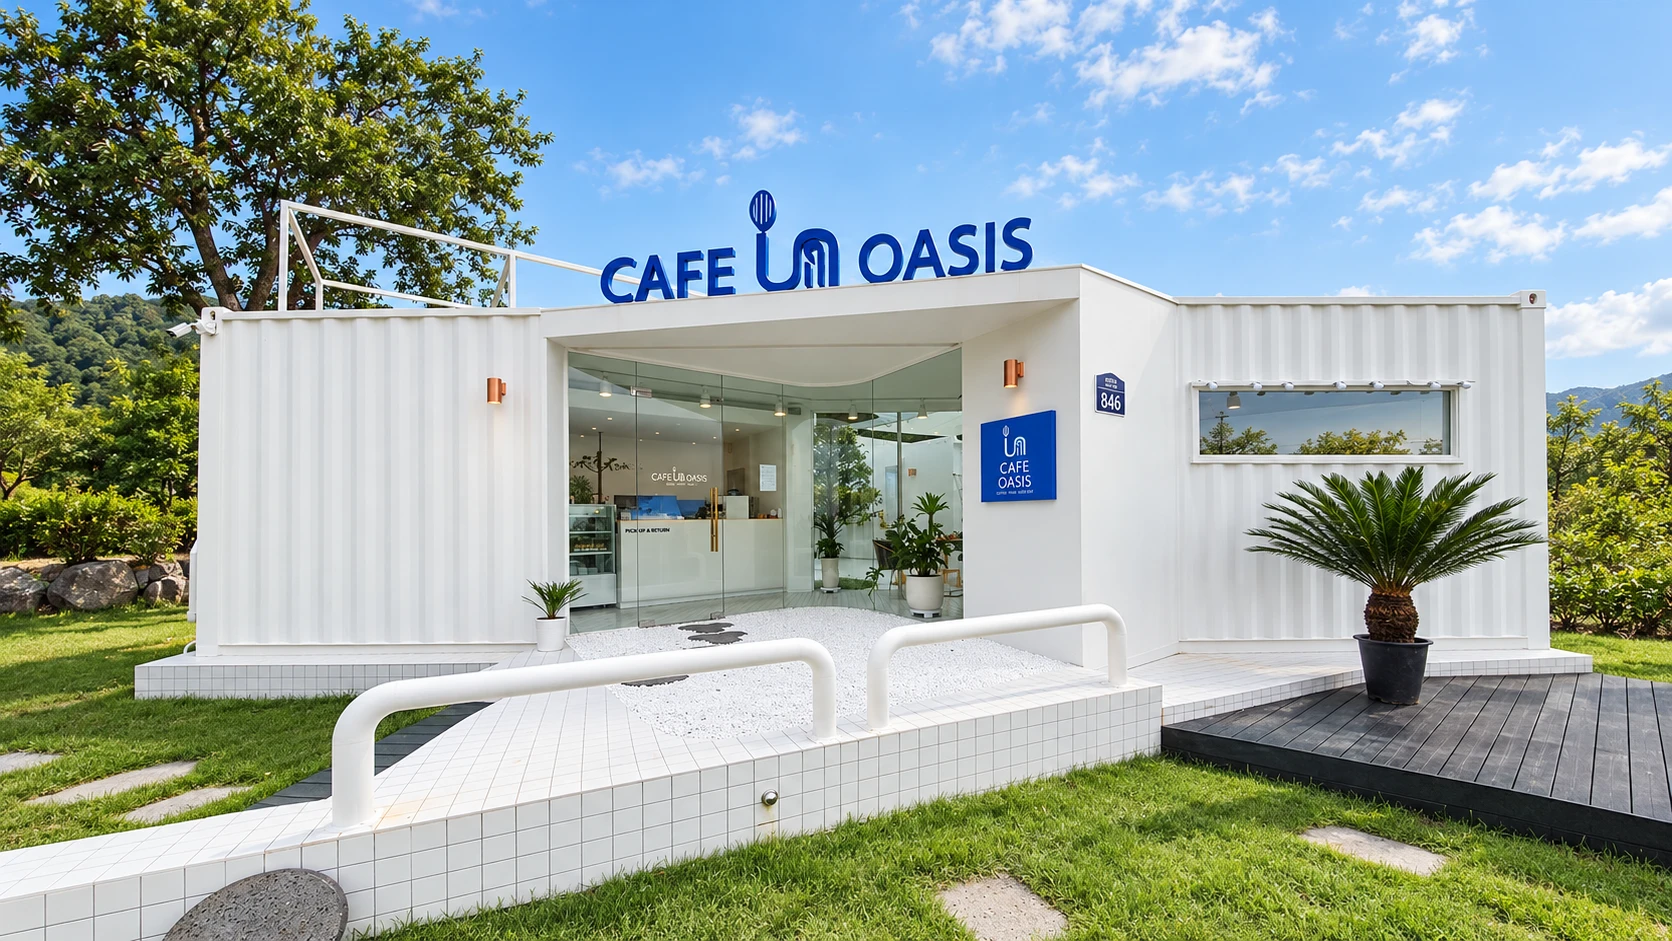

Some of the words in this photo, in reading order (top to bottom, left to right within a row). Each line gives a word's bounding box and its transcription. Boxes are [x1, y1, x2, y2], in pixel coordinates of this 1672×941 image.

[600, 247, 736, 304] CAFE
[859, 217, 1034, 284] OASIS
[1101, 392, 1121, 411] 846
[1000, 460, 1030, 474] CAFE
[651, 472, 672, 481] CAFE
[998, 475, 1032, 489] OASIS
